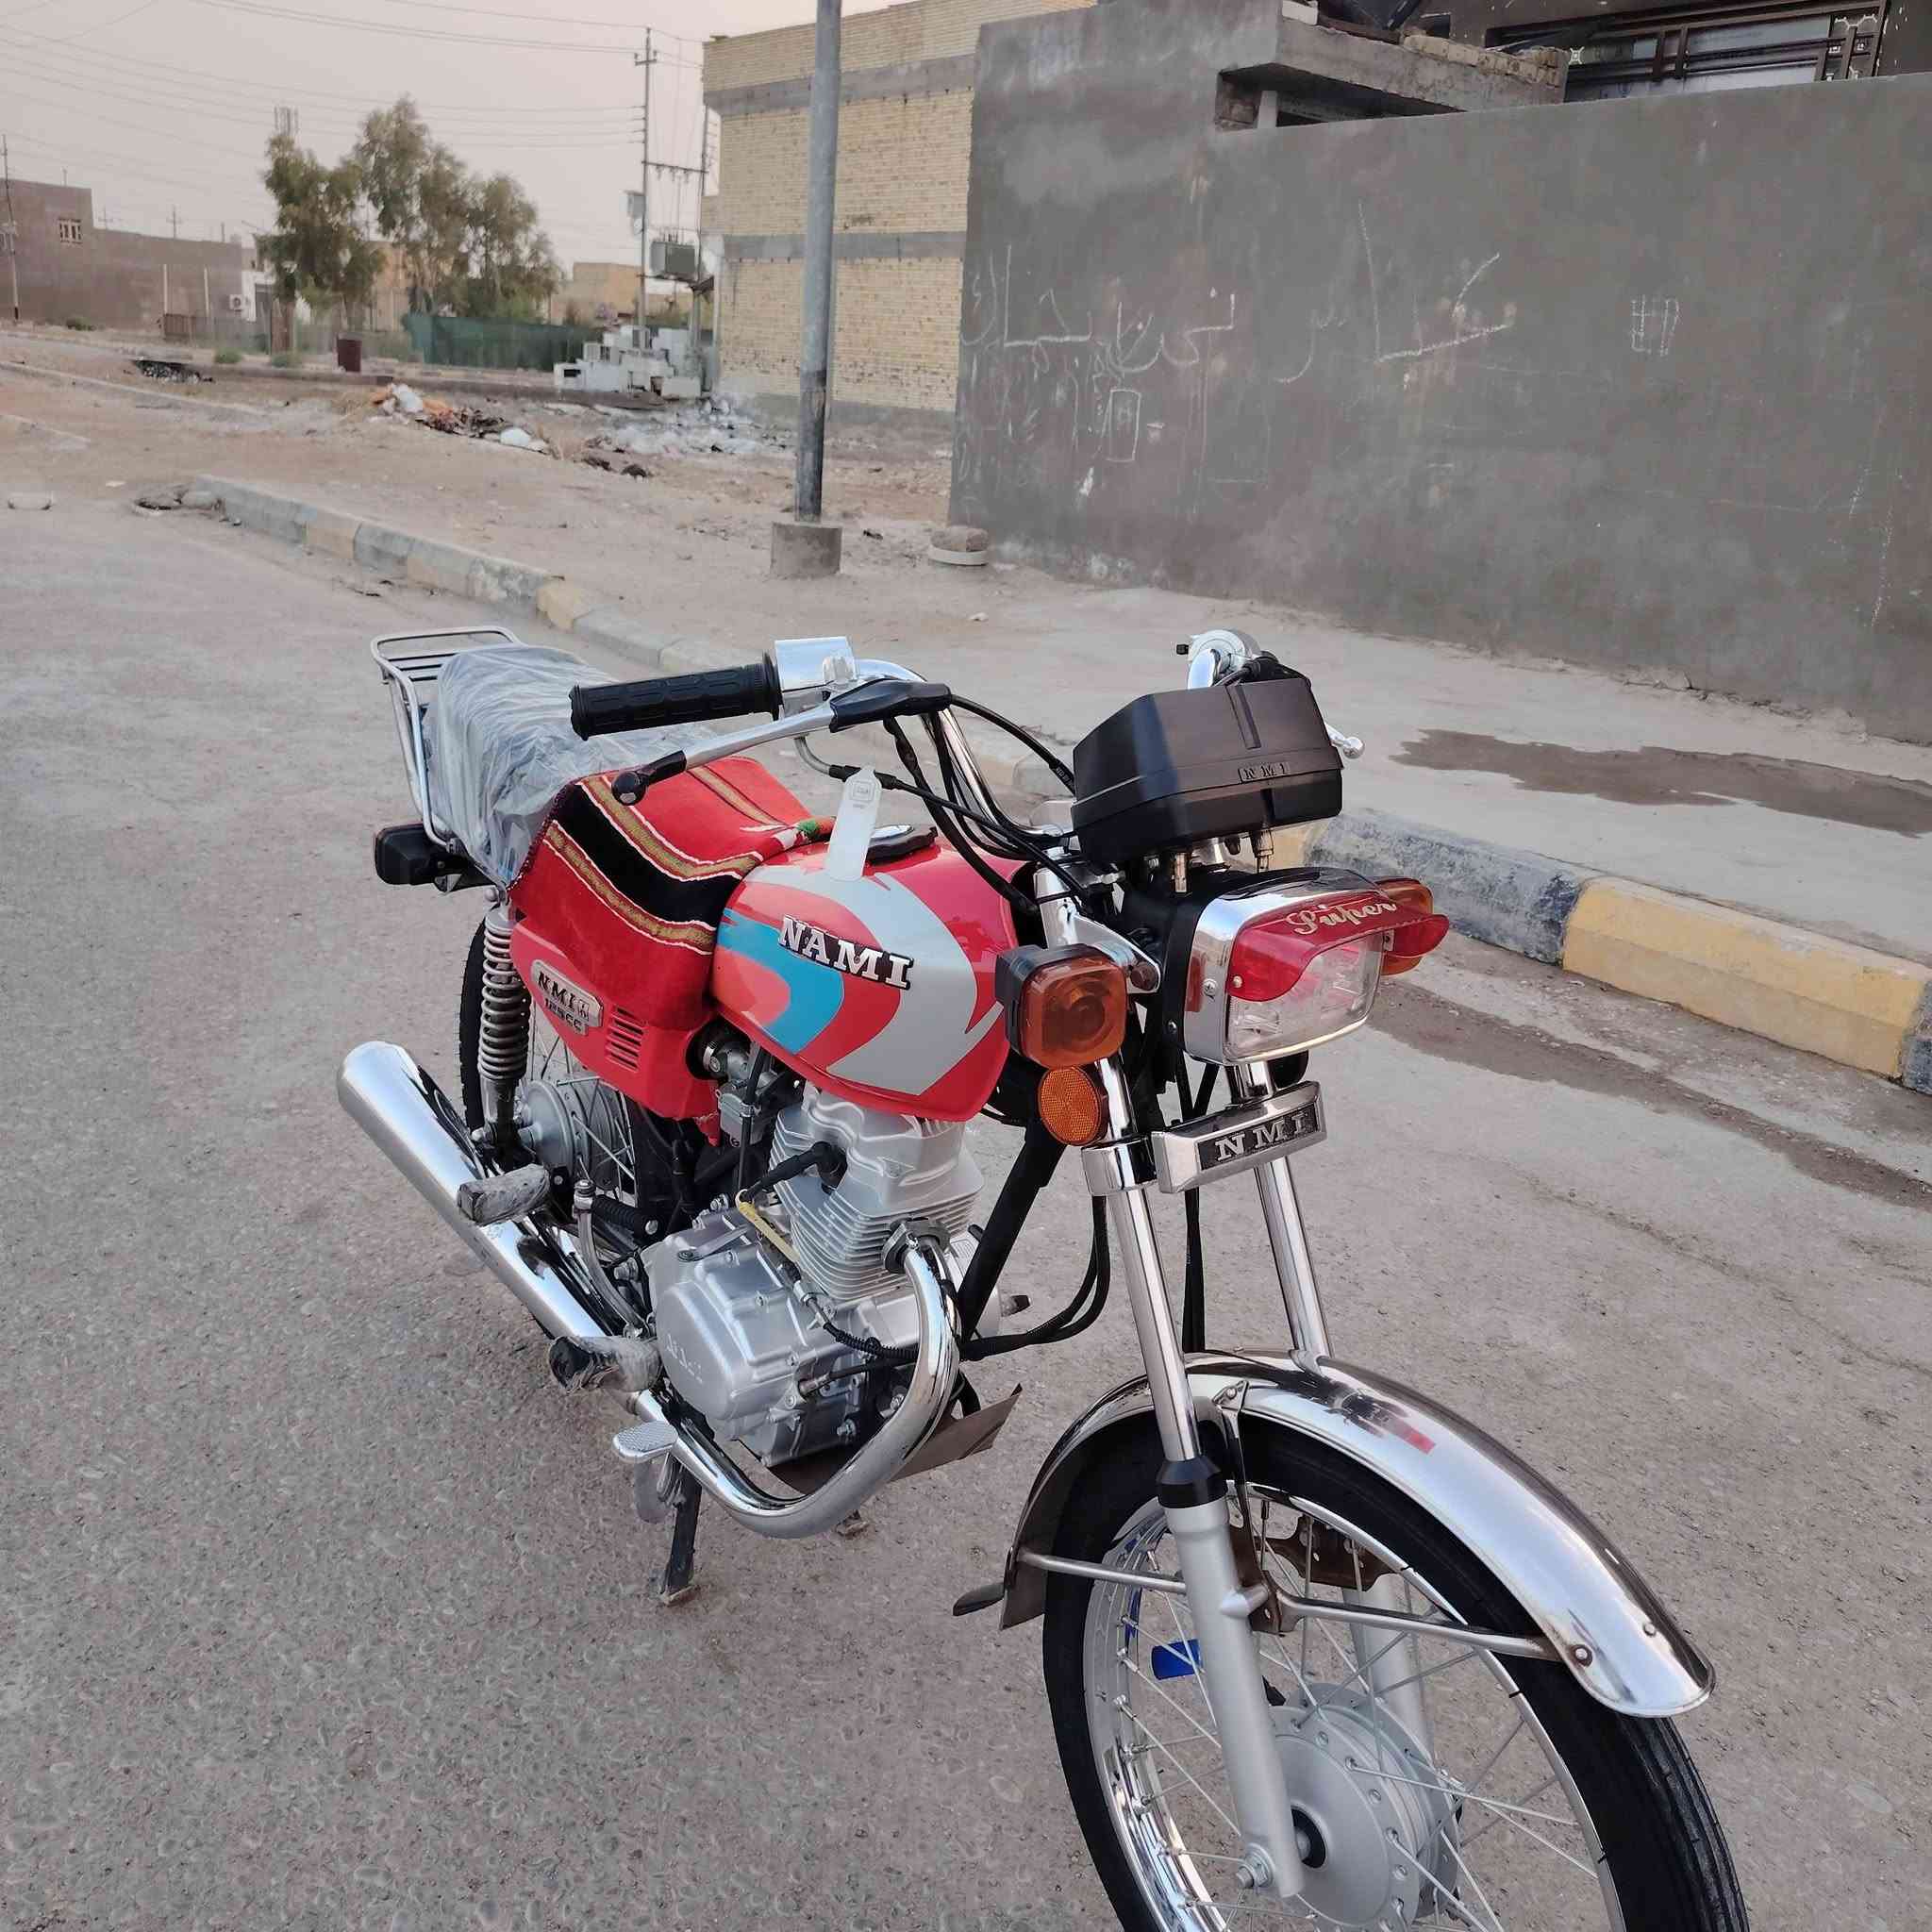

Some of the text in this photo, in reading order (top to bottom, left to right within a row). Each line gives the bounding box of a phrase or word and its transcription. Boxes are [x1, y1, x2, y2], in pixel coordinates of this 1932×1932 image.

[1285, 902, 1396, 935] Super
[778, 916, 912, 989] NAMI
[1215, 1110, 1309, 1161] NMI
